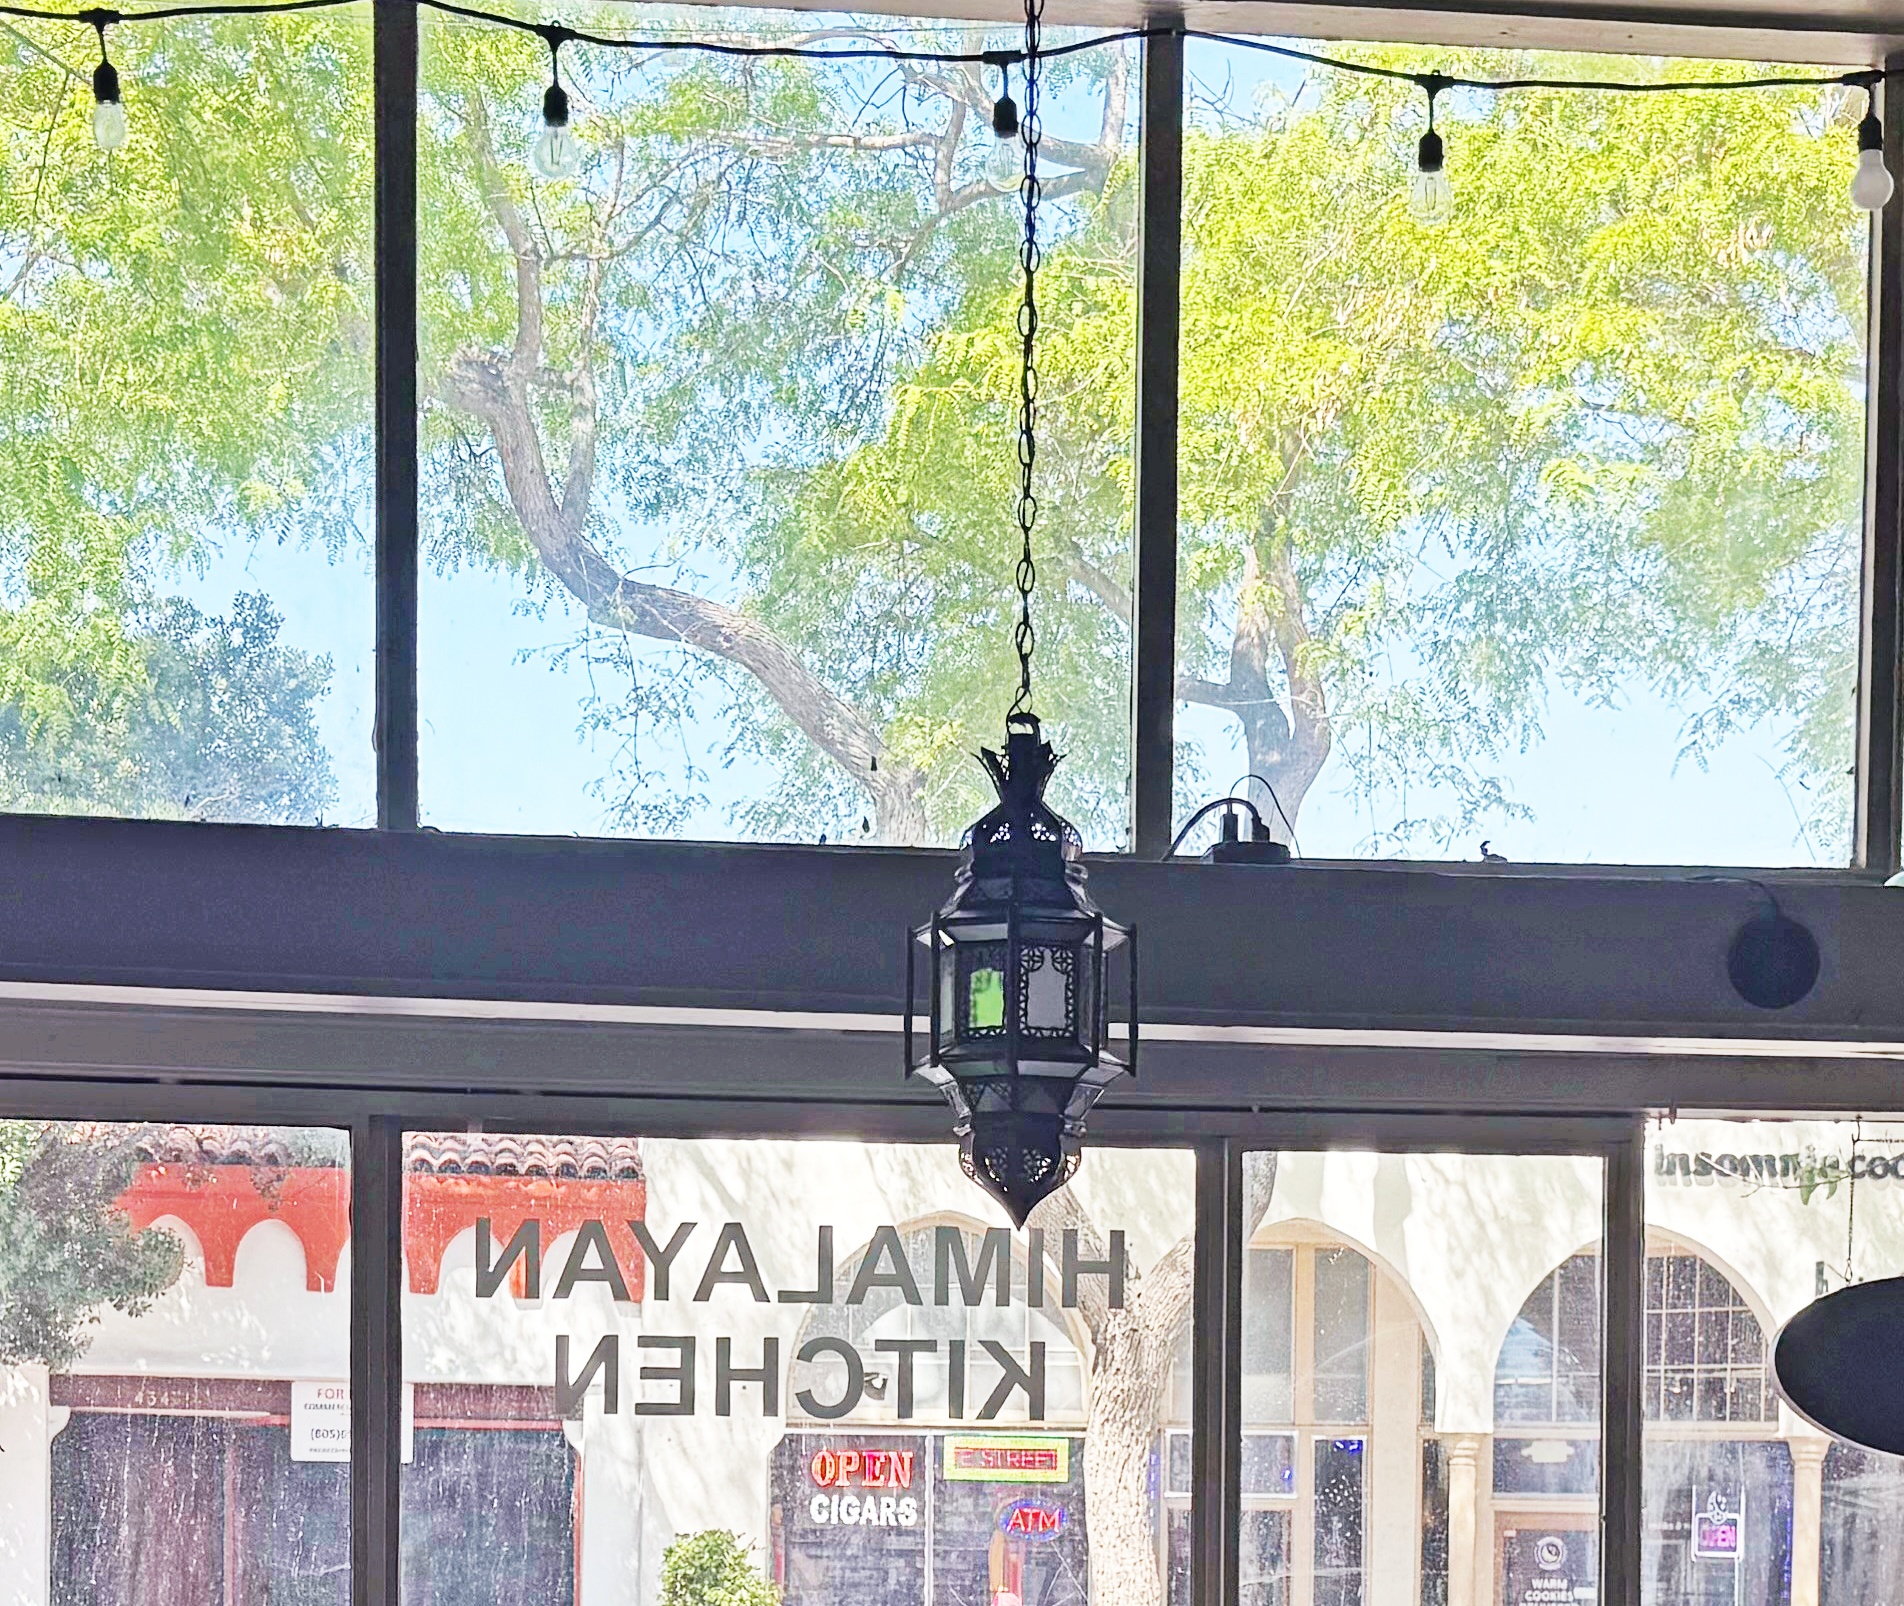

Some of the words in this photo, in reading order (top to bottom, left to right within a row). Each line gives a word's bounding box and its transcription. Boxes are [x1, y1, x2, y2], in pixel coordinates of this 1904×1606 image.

[811, 1450, 914, 1489] OPEN
[809, 1494, 919, 1527] CIGARS
[1006, 1508, 1062, 1533] ATM
[1524, 1590, 1574, 1602] COOKIES
